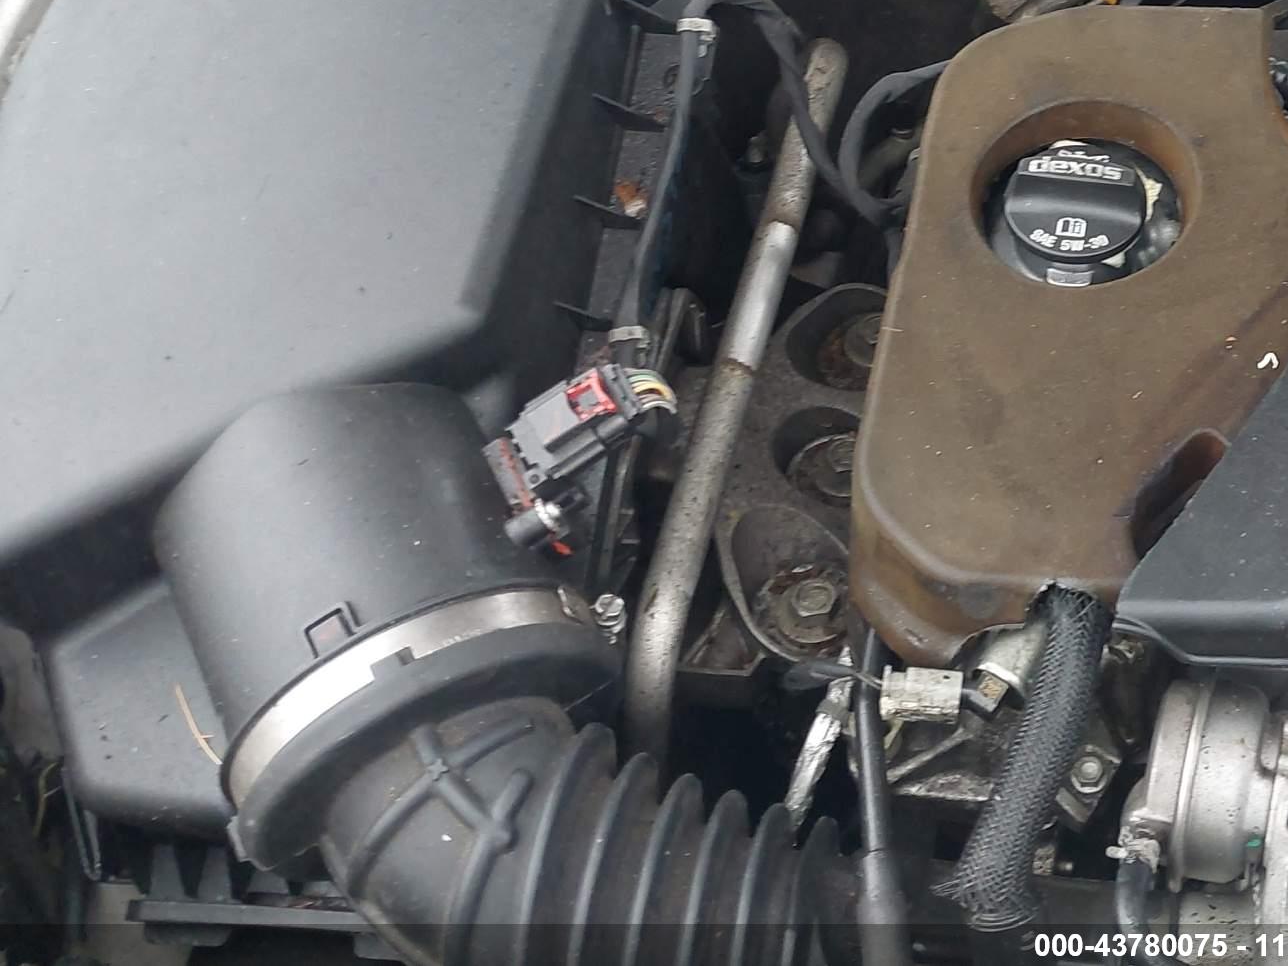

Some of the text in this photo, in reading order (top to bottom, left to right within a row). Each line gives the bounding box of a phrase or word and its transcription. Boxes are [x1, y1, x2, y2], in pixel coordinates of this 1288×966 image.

[1028, 156, 1123, 181] dexos
[1029, 228, 1110, 251] SAE 5W-30
